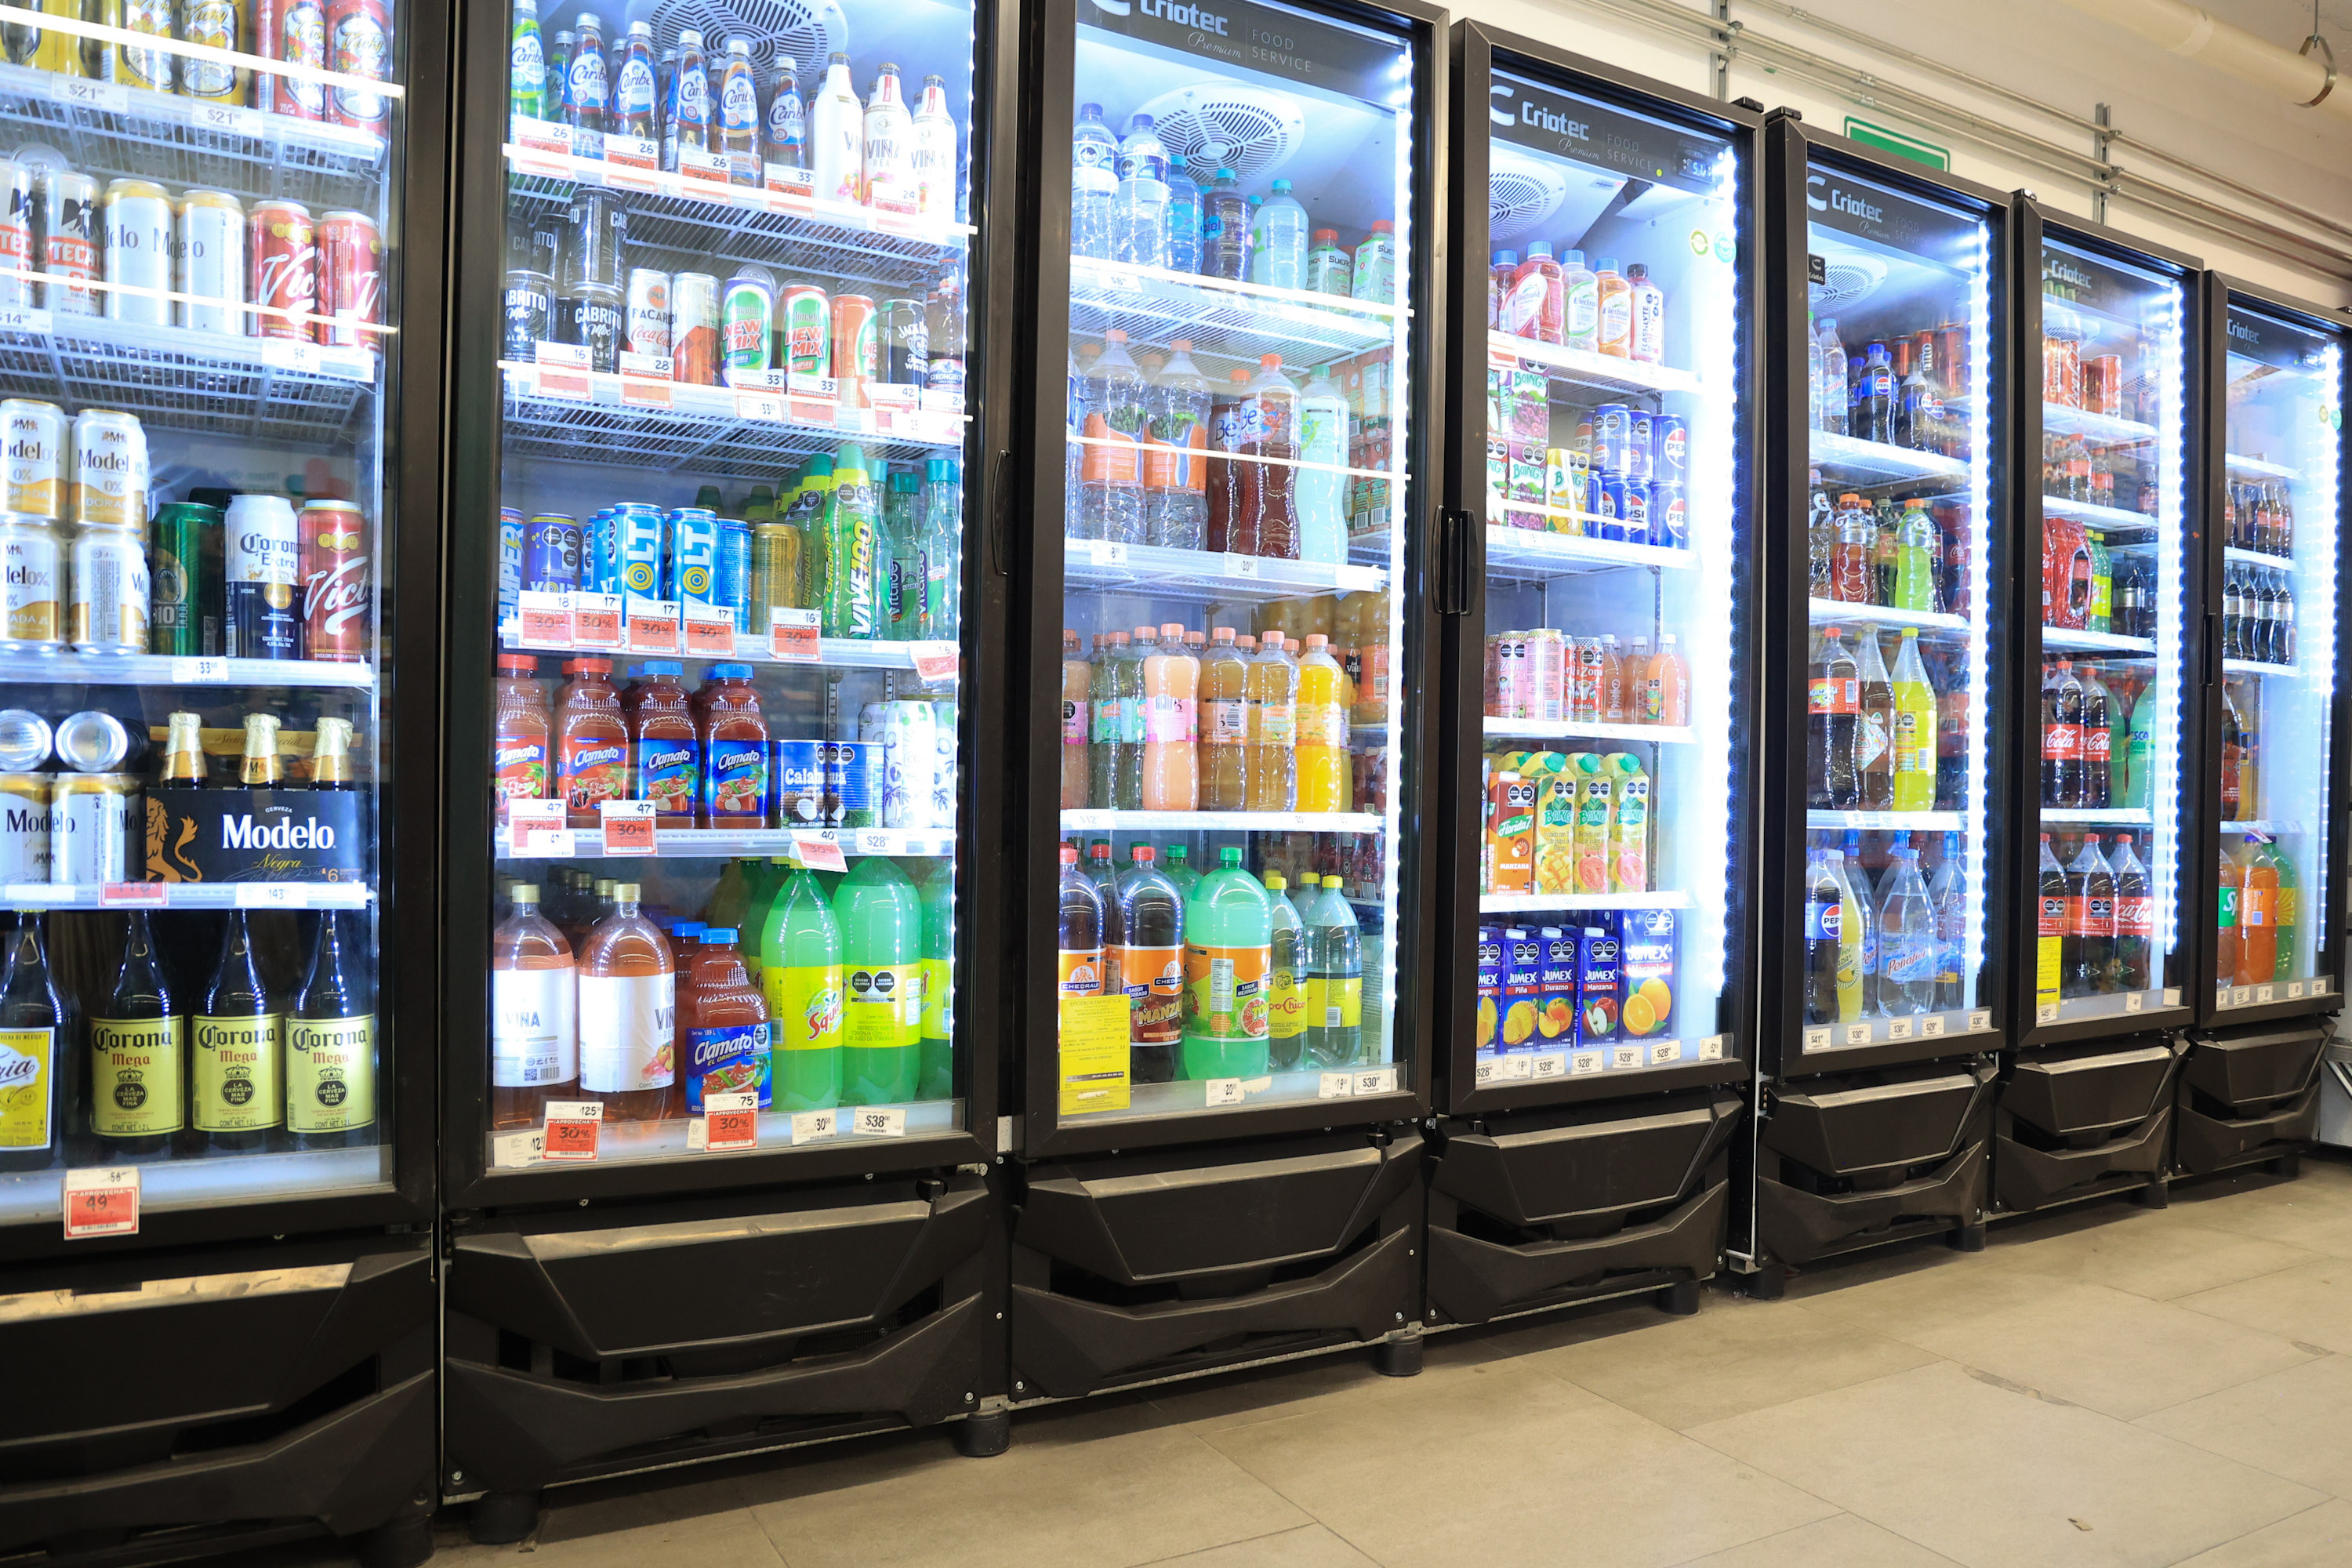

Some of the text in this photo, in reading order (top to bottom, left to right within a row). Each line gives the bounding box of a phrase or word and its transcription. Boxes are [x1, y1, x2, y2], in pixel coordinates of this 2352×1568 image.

[1187, 31, 1243, 59] Premium
[1252, 29, 1294, 50] FOOD
[1252, 46, 1312, 73] SERVICE
[571, 63, 608, 85] Caribe
[619, 71, 652, 93] Caribe
[1522, 100, 1590, 142] Criotec
[1559, 137, 1600, 162] Premium
[1607, 134, 1640, 152] FOOD
[1606, 150, 1653, 172] SERVICE
[1831, 188, 1882, 223] Criotec
[2052, 260, 2092, 289] Criotec
[1517, 287, 1541, 303] Electrolit
[575, 307, 622, 330] CABRITO
[723, 318, 762, 340] NEW
[786, 326, 824, 347] NEW
[727, 333, 762, 353] MIX
[792, 341, 823, 358] MIX
[627, 368, 665, 377] ¡APROVECHA!
[792, 360, 813, 370] AMPIRO
[1514, 371, 1548, 389] BOING!
[1512, 463, 1545, 480] BOING!
[823, 521, 835, 593] ORIGINAL
[582, 616, 612, 628] 30%
[641, 623, 671, 636] 30%
[698, 627, 726, 638] 30%
[784, 632, 811, 643] 30%
[495, 744, 539, 765] Clamato
[575, 746, 619, 767] Clamato
[587, 758, 608, 767] CUBANO
[648, 749, 690, 769] Clamato
[717, 750, 760, 770] Clamato
[222, 814, 336, 850] Modelo
[617, 824, 647, 836] 30%
[252, 853, 301, 872] Negra
[328, 868, 339, 882] 6
[1627, 943, 1668, 961] JUMEX
[1887, 949, 1927, 978] Peñafiel
[1507, 972, 1537, 985] JUMEX
[1542, 968, 1572, 982] JUMEX
[1584, 969, 1616, 981] JUMEX
[1237, 986, 1258, 996] MEJORADO
[1283, 997, 1308, 1014] Chico
[93, 1025, 173, 1054] Corona
[198, 1025, 276, 1052] Corona
[292, 1027, 367, 1054] Corona
[220, 1050, 257, 1064] Mega
[694, 1031, 753, 1066] Clamato
[717, 1050, 744, 1063] ORIGINAL
[112, 1053, 151, 1067] Mega
[313, 1052, 350, 1065] Mega
[559, 1127, 590, 1139] 30%
[720, 1118, 749, 1131] 30%
